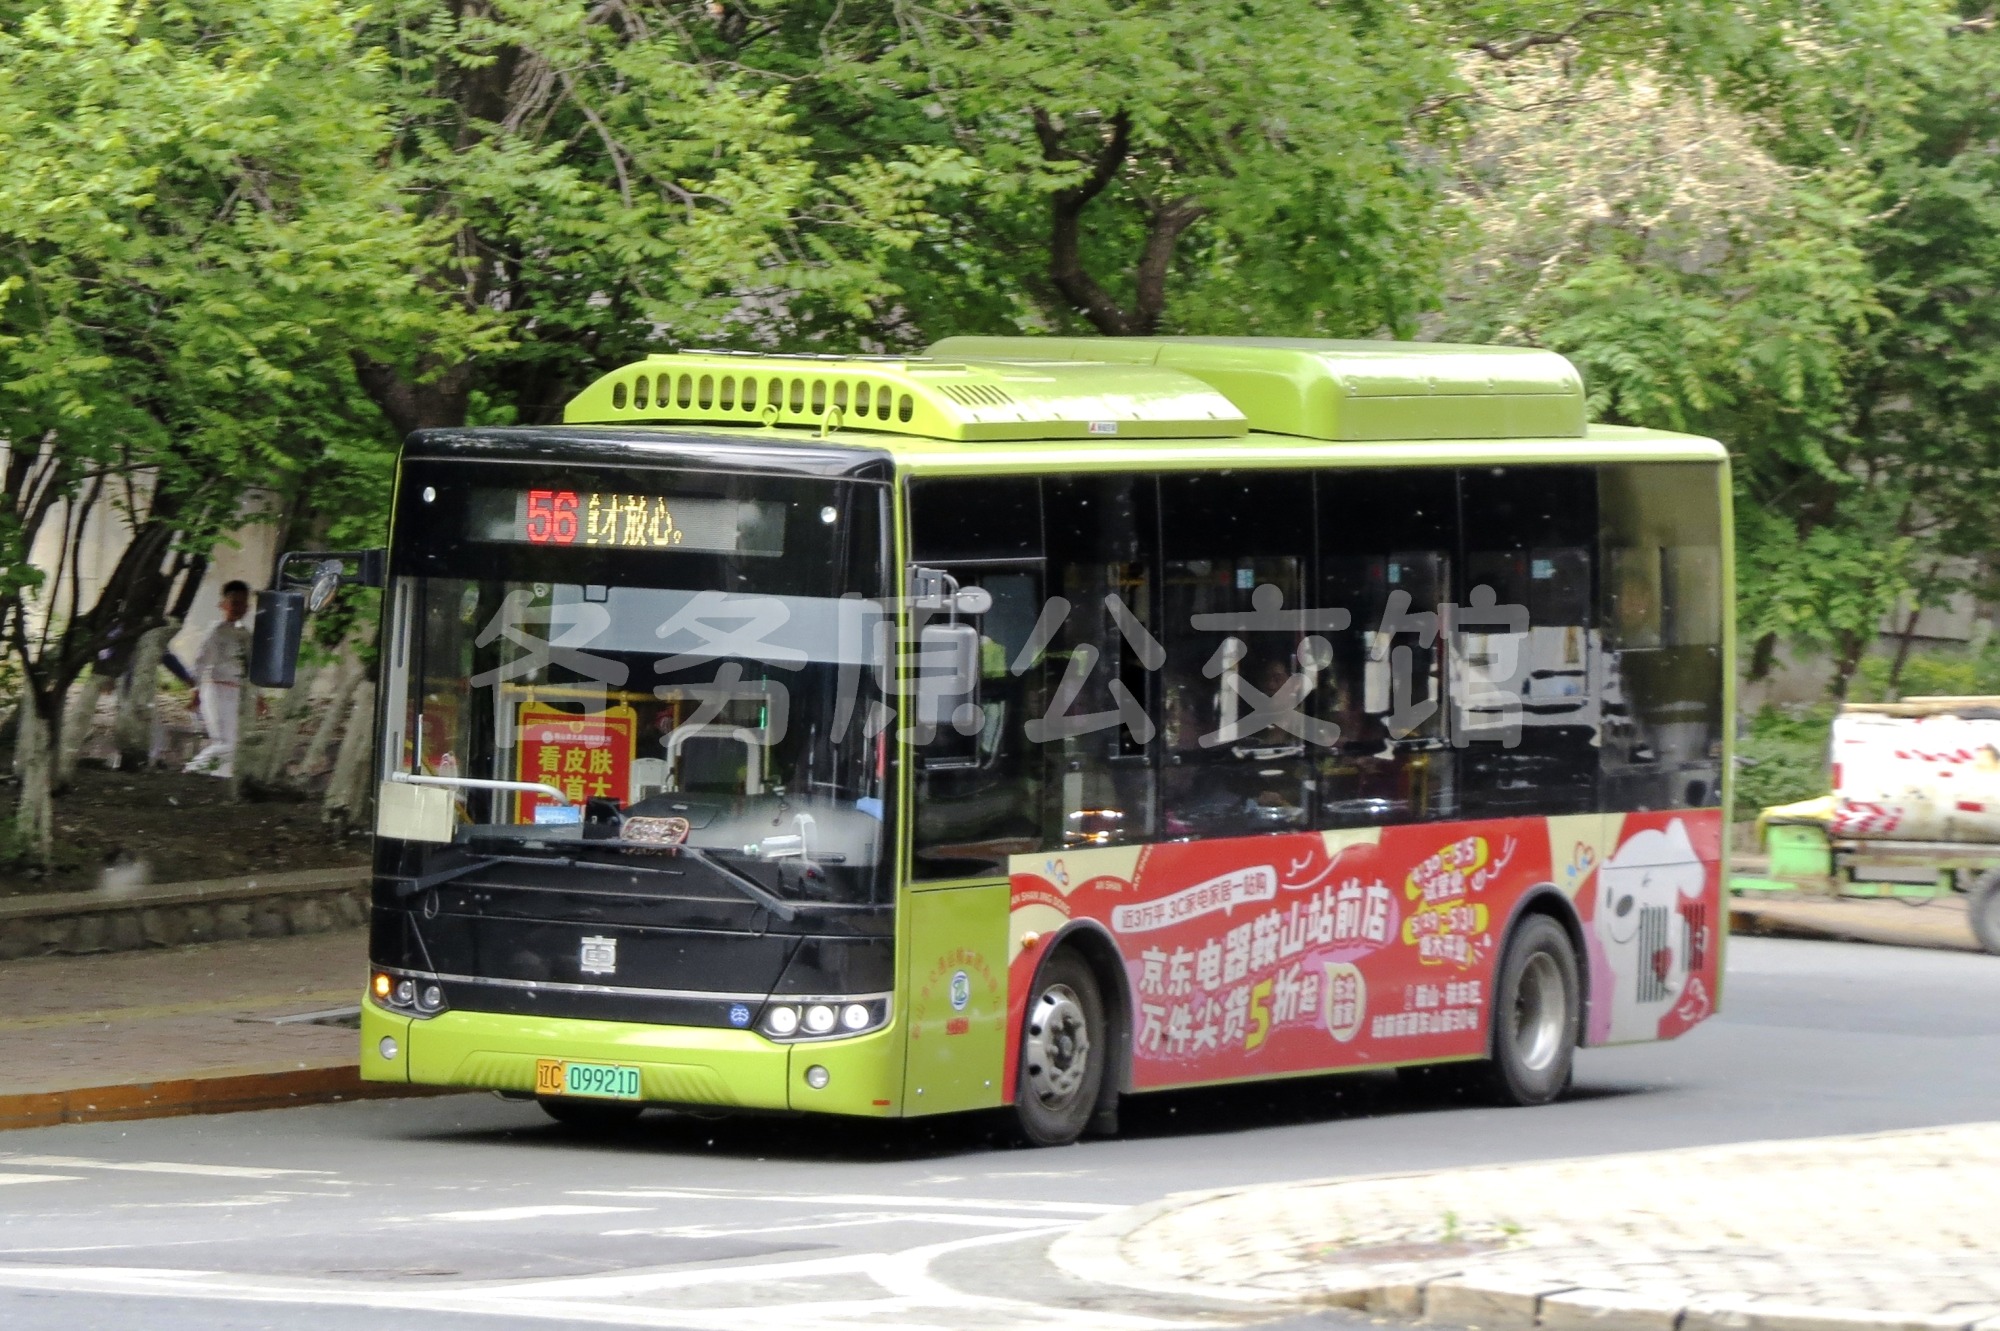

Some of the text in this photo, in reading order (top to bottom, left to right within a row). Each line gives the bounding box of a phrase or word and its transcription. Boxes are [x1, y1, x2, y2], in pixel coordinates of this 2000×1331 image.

[527, 490, 578, 545] 56
[538, 745, 613, 775] 看皮肤
[1122, 872, 1267, 928] 近3万平 3C家电家居一站购
[1139, 877, 1390, 996] 京东电器鞍山站前店
[1139, 961, 1319, 1053] 万件尖货5折起
